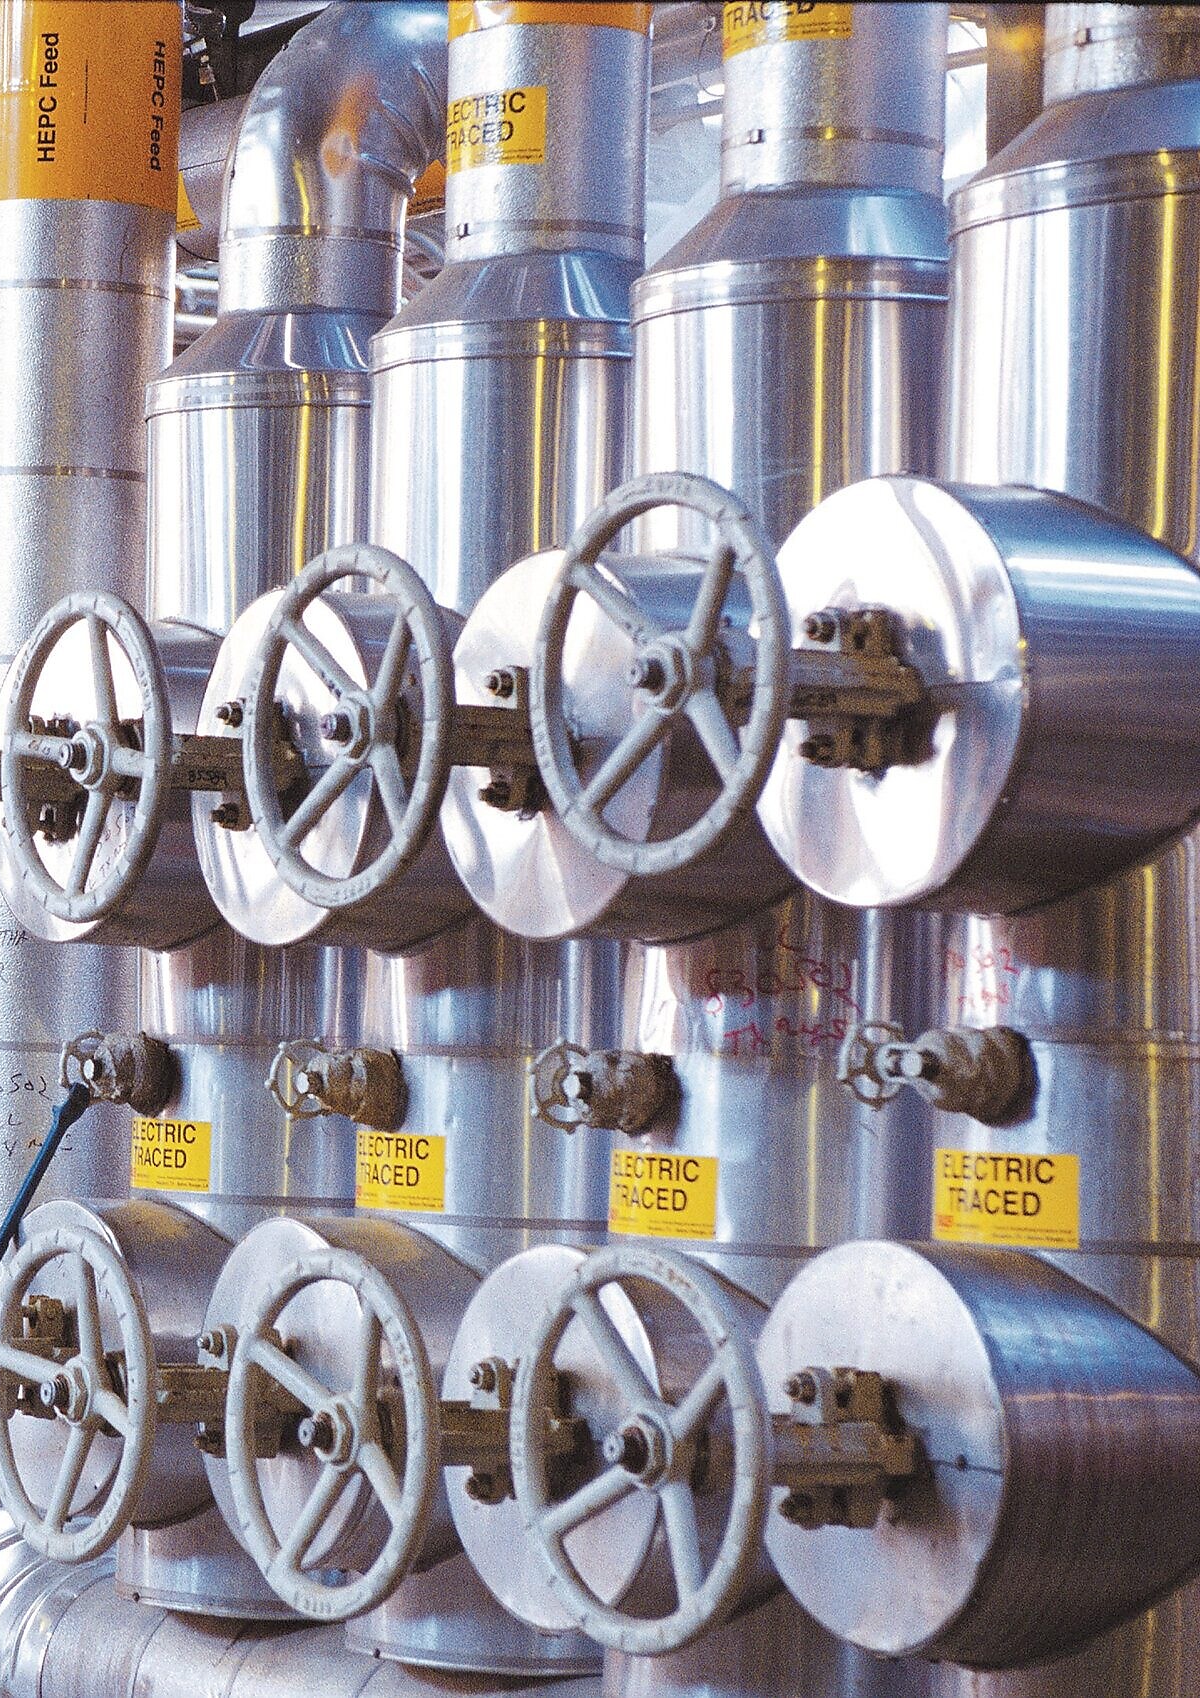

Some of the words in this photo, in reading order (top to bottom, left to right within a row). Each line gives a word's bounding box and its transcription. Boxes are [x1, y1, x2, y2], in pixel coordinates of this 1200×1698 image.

[39, 32, 59, 88] Feed
[151, 40, 166, 108] HEPC
[37, 98, 57, 163] HEPC
[150, 114, 164, 172] Feed
[132, 1121, 197, 1145] ELECTRIC
[358, 1134, 430, 1160] ELECTRIC
[134, 1145, 187, 1169] TRACED
[614, 1153, 701, 1183] ELECTRIC
[943, 1153, 1056, 1184] ELECTRIC
[360, 1162, 420, 1187] TRACED
[616, 1184, 688, 1212] TRACED
[948, 1187, 1042, 1217] TRACED
